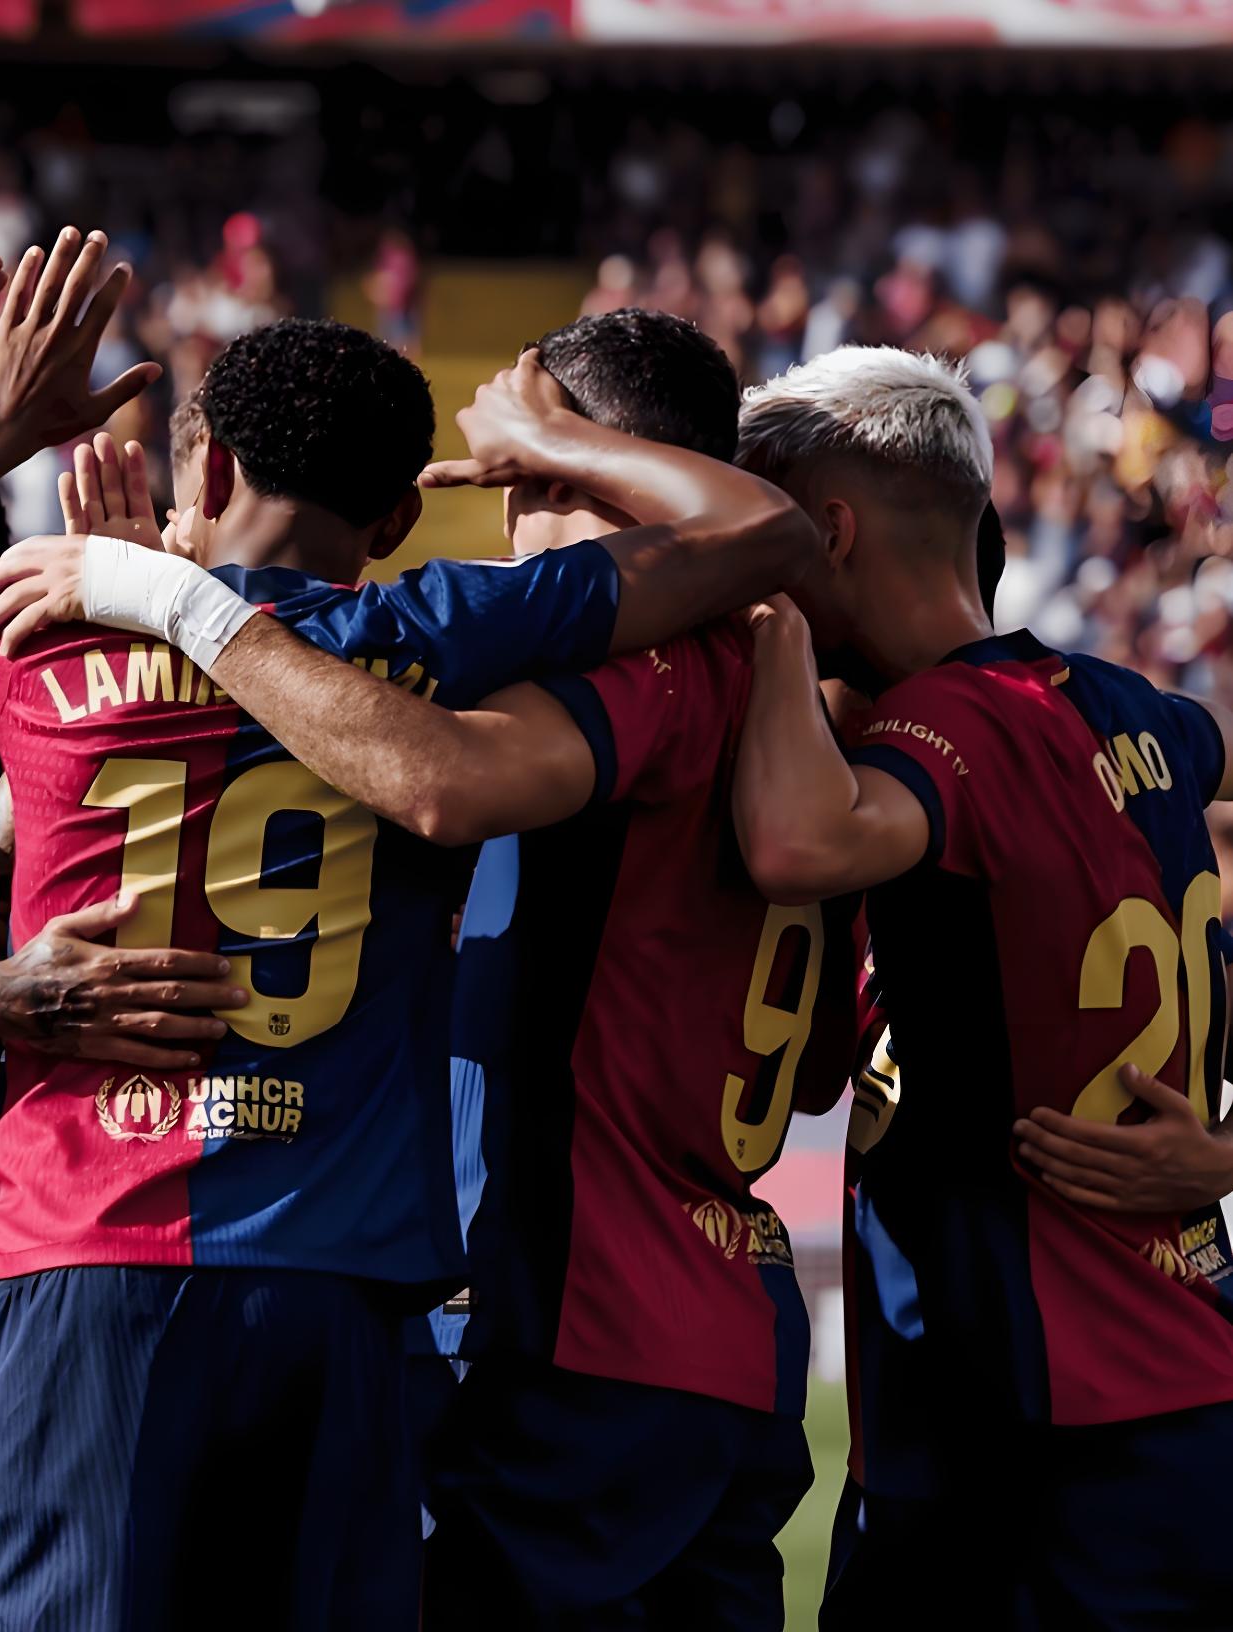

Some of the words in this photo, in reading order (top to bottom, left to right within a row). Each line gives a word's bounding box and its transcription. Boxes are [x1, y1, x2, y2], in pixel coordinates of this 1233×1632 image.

[82, 758, 378, 1048] 19
[187, 1076, 305, 1107] UNHCR
[721, 902, 825, 1172] 9
[187, 1101, 302, 1133] ACNUR
